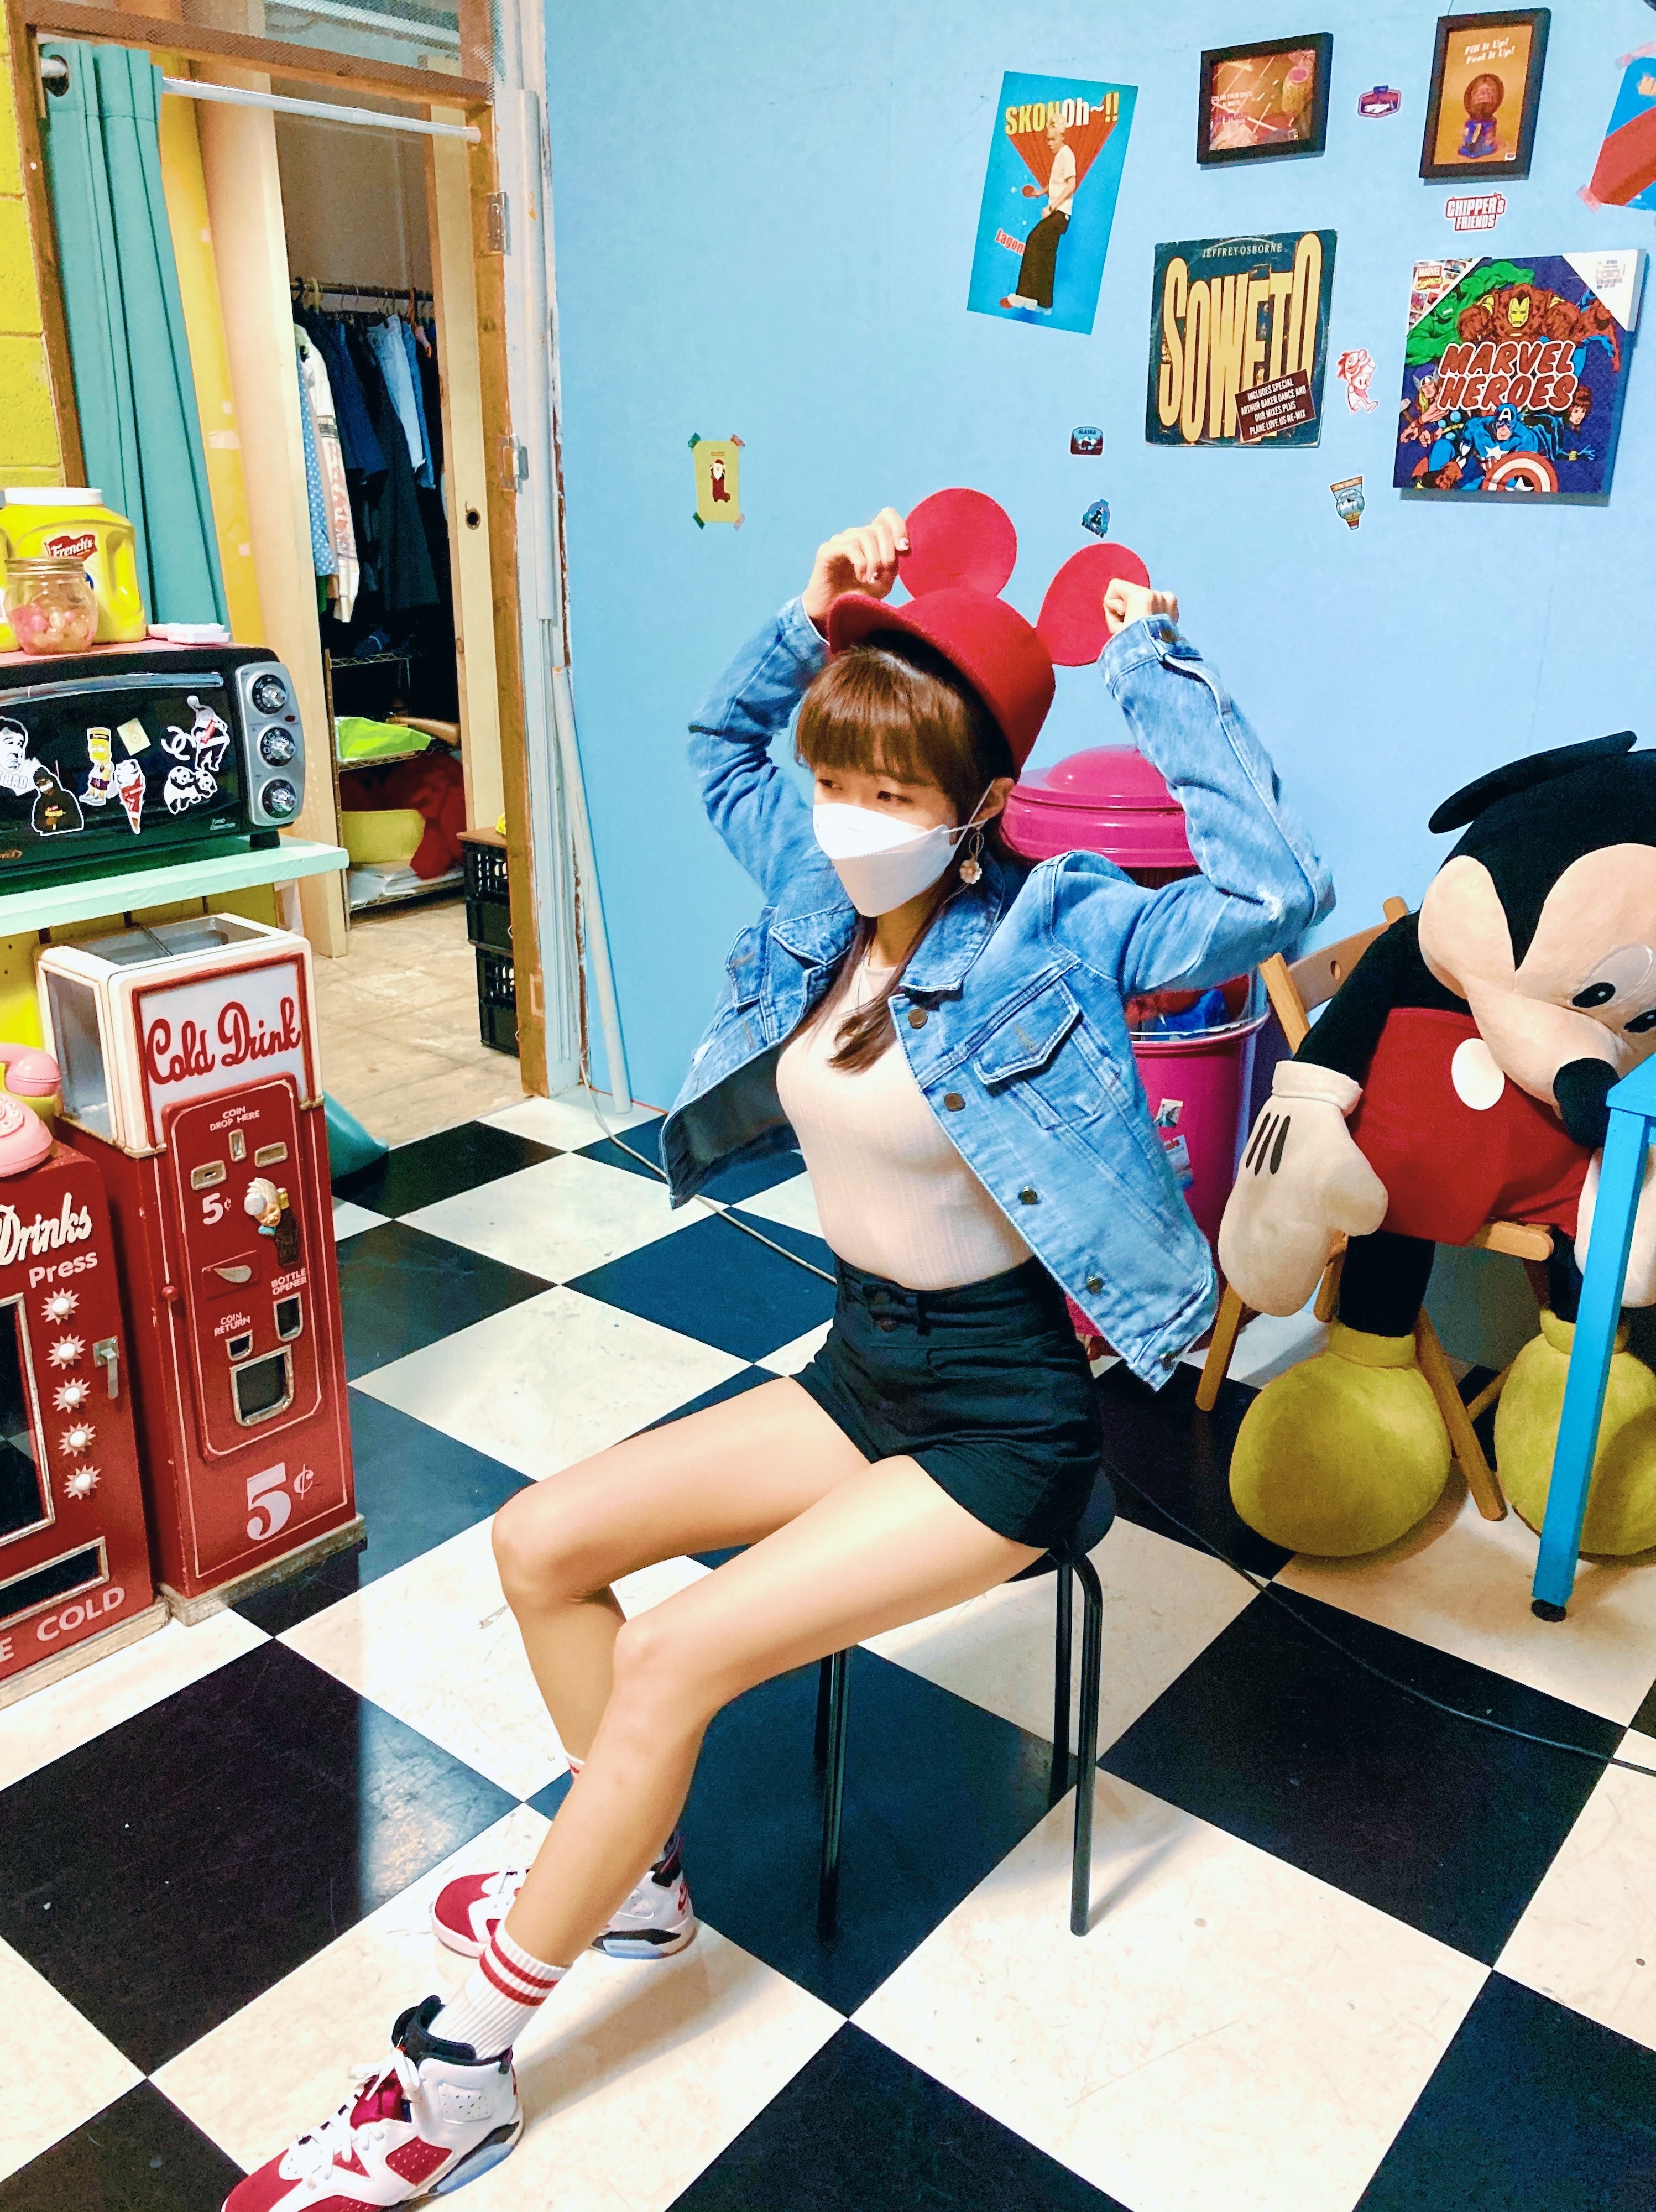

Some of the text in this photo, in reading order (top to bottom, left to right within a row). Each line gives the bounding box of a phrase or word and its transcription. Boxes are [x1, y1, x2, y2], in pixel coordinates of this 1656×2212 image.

[1455, 214, 1495, 230] FRIENDS
[1202, 242, 1282, 258] JEFFREY OSBORNE
[1159, 232, 1322, 443] SOWETO
[1440, 341, 1576, 377] MARVEL
[1247, 378, 1294, 401] INCLUDES SPECIAL
[1438, 374, 1579, 411] HEROES
[1241, 385, 1307, 416] ARTHUR BAKER DANCE AND
[1254, 400, 1296, 422] DUB MIXES PLUS
[1249, 409, 1306, 435] PLANE LOVE US RE-MIX
[51, 538, 93, 557] French's
[3, 772, 28, 789] BAD
[144, 997, 301, 1086] Cold Drink
[210, 1110, 260, 1131] DROP HERE
[222, 1106, 246, 1119] COIN
[29, 1252, 98, 1289] Press
[271, 1267, 306, 1288] BOTTLE
[272, 1276, 307, 1295] OPENER
[214, 1316, 250, 1337] RETURN
[221, 1312, 242, 1325] COIN
[37, 1587, 125, 1641] COLD
